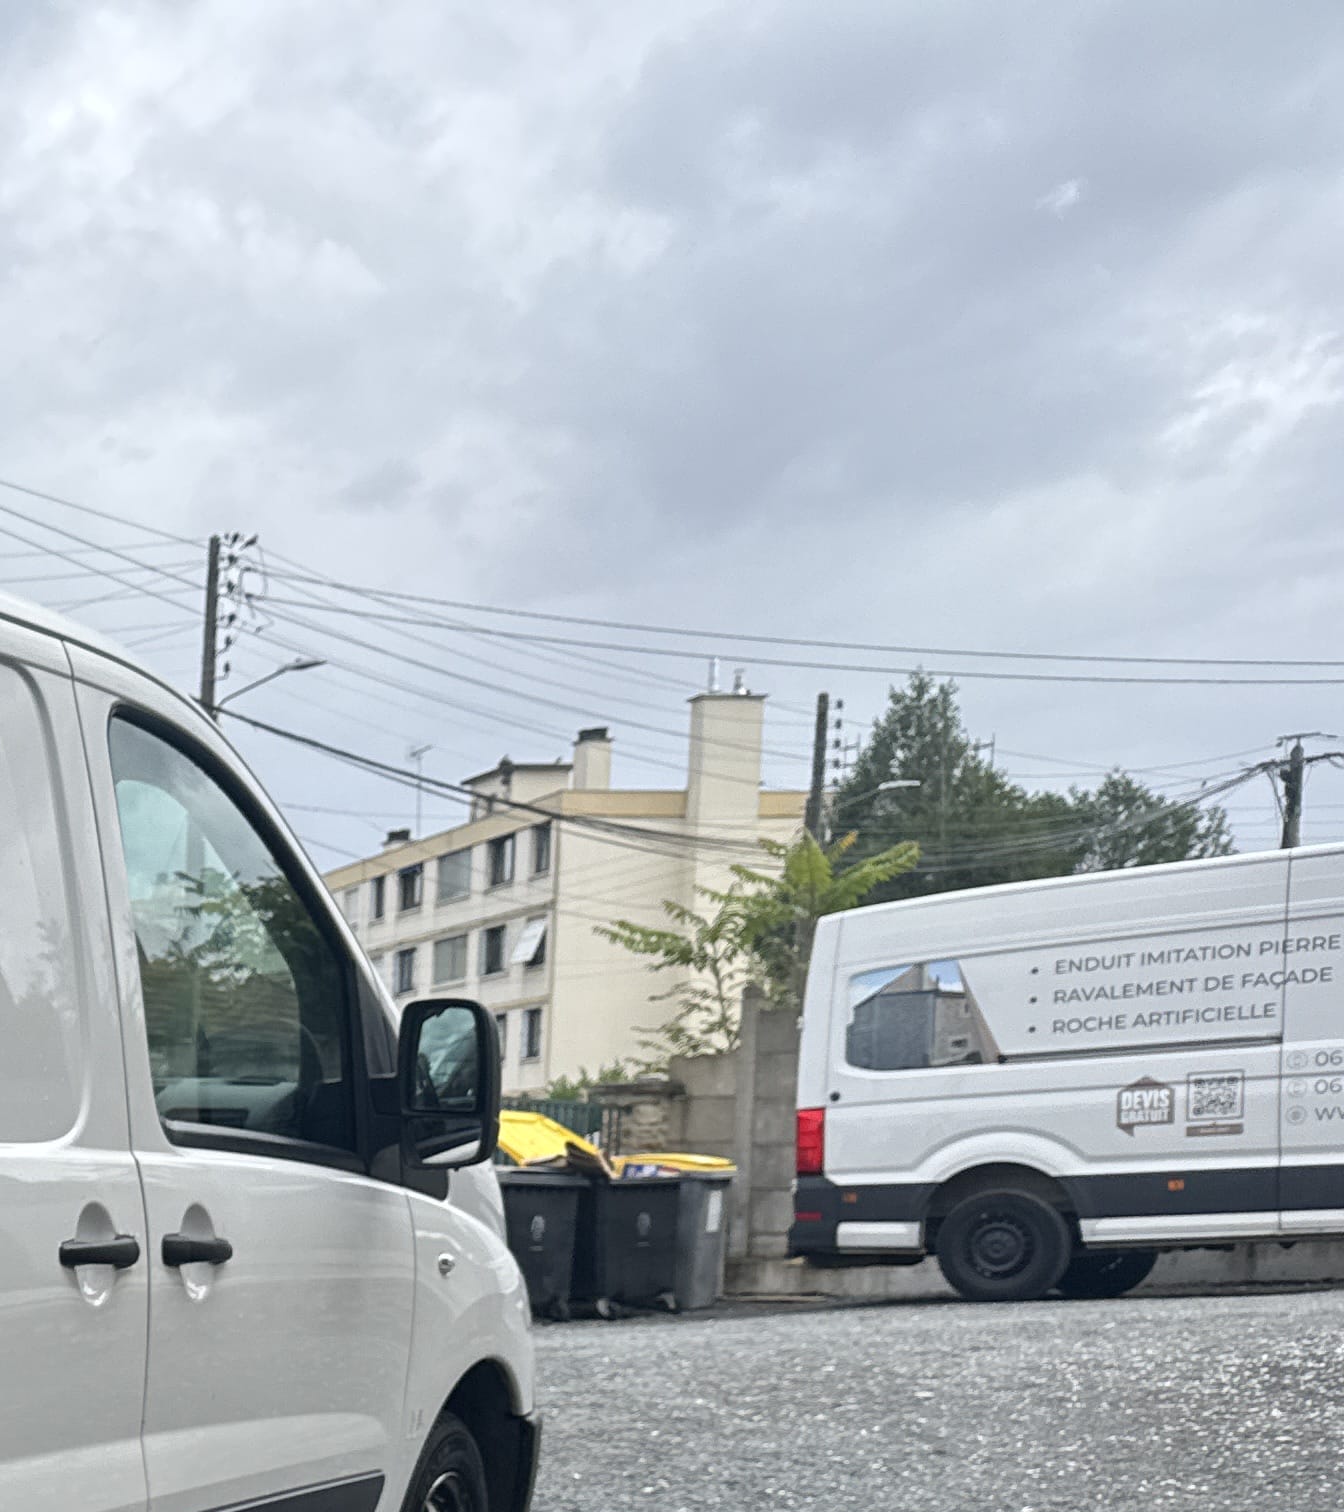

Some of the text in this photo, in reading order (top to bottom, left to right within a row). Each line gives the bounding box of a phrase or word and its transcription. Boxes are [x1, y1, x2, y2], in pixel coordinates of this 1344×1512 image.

[1054, 934, 1342, 975] ENDUIT IMITATION PIERRE
[1053, 966, 1334, 1004] RAVALEMENT DE FAÇADE
[1052, 1002, 1277, 1034] ROCHE ARTIFICIELLE
[1315, 1049, 1343, 1066] 06
[1314, 1077, 1342, 1094] 06
[1121, 1089, 1170, 1110] DEVIS
